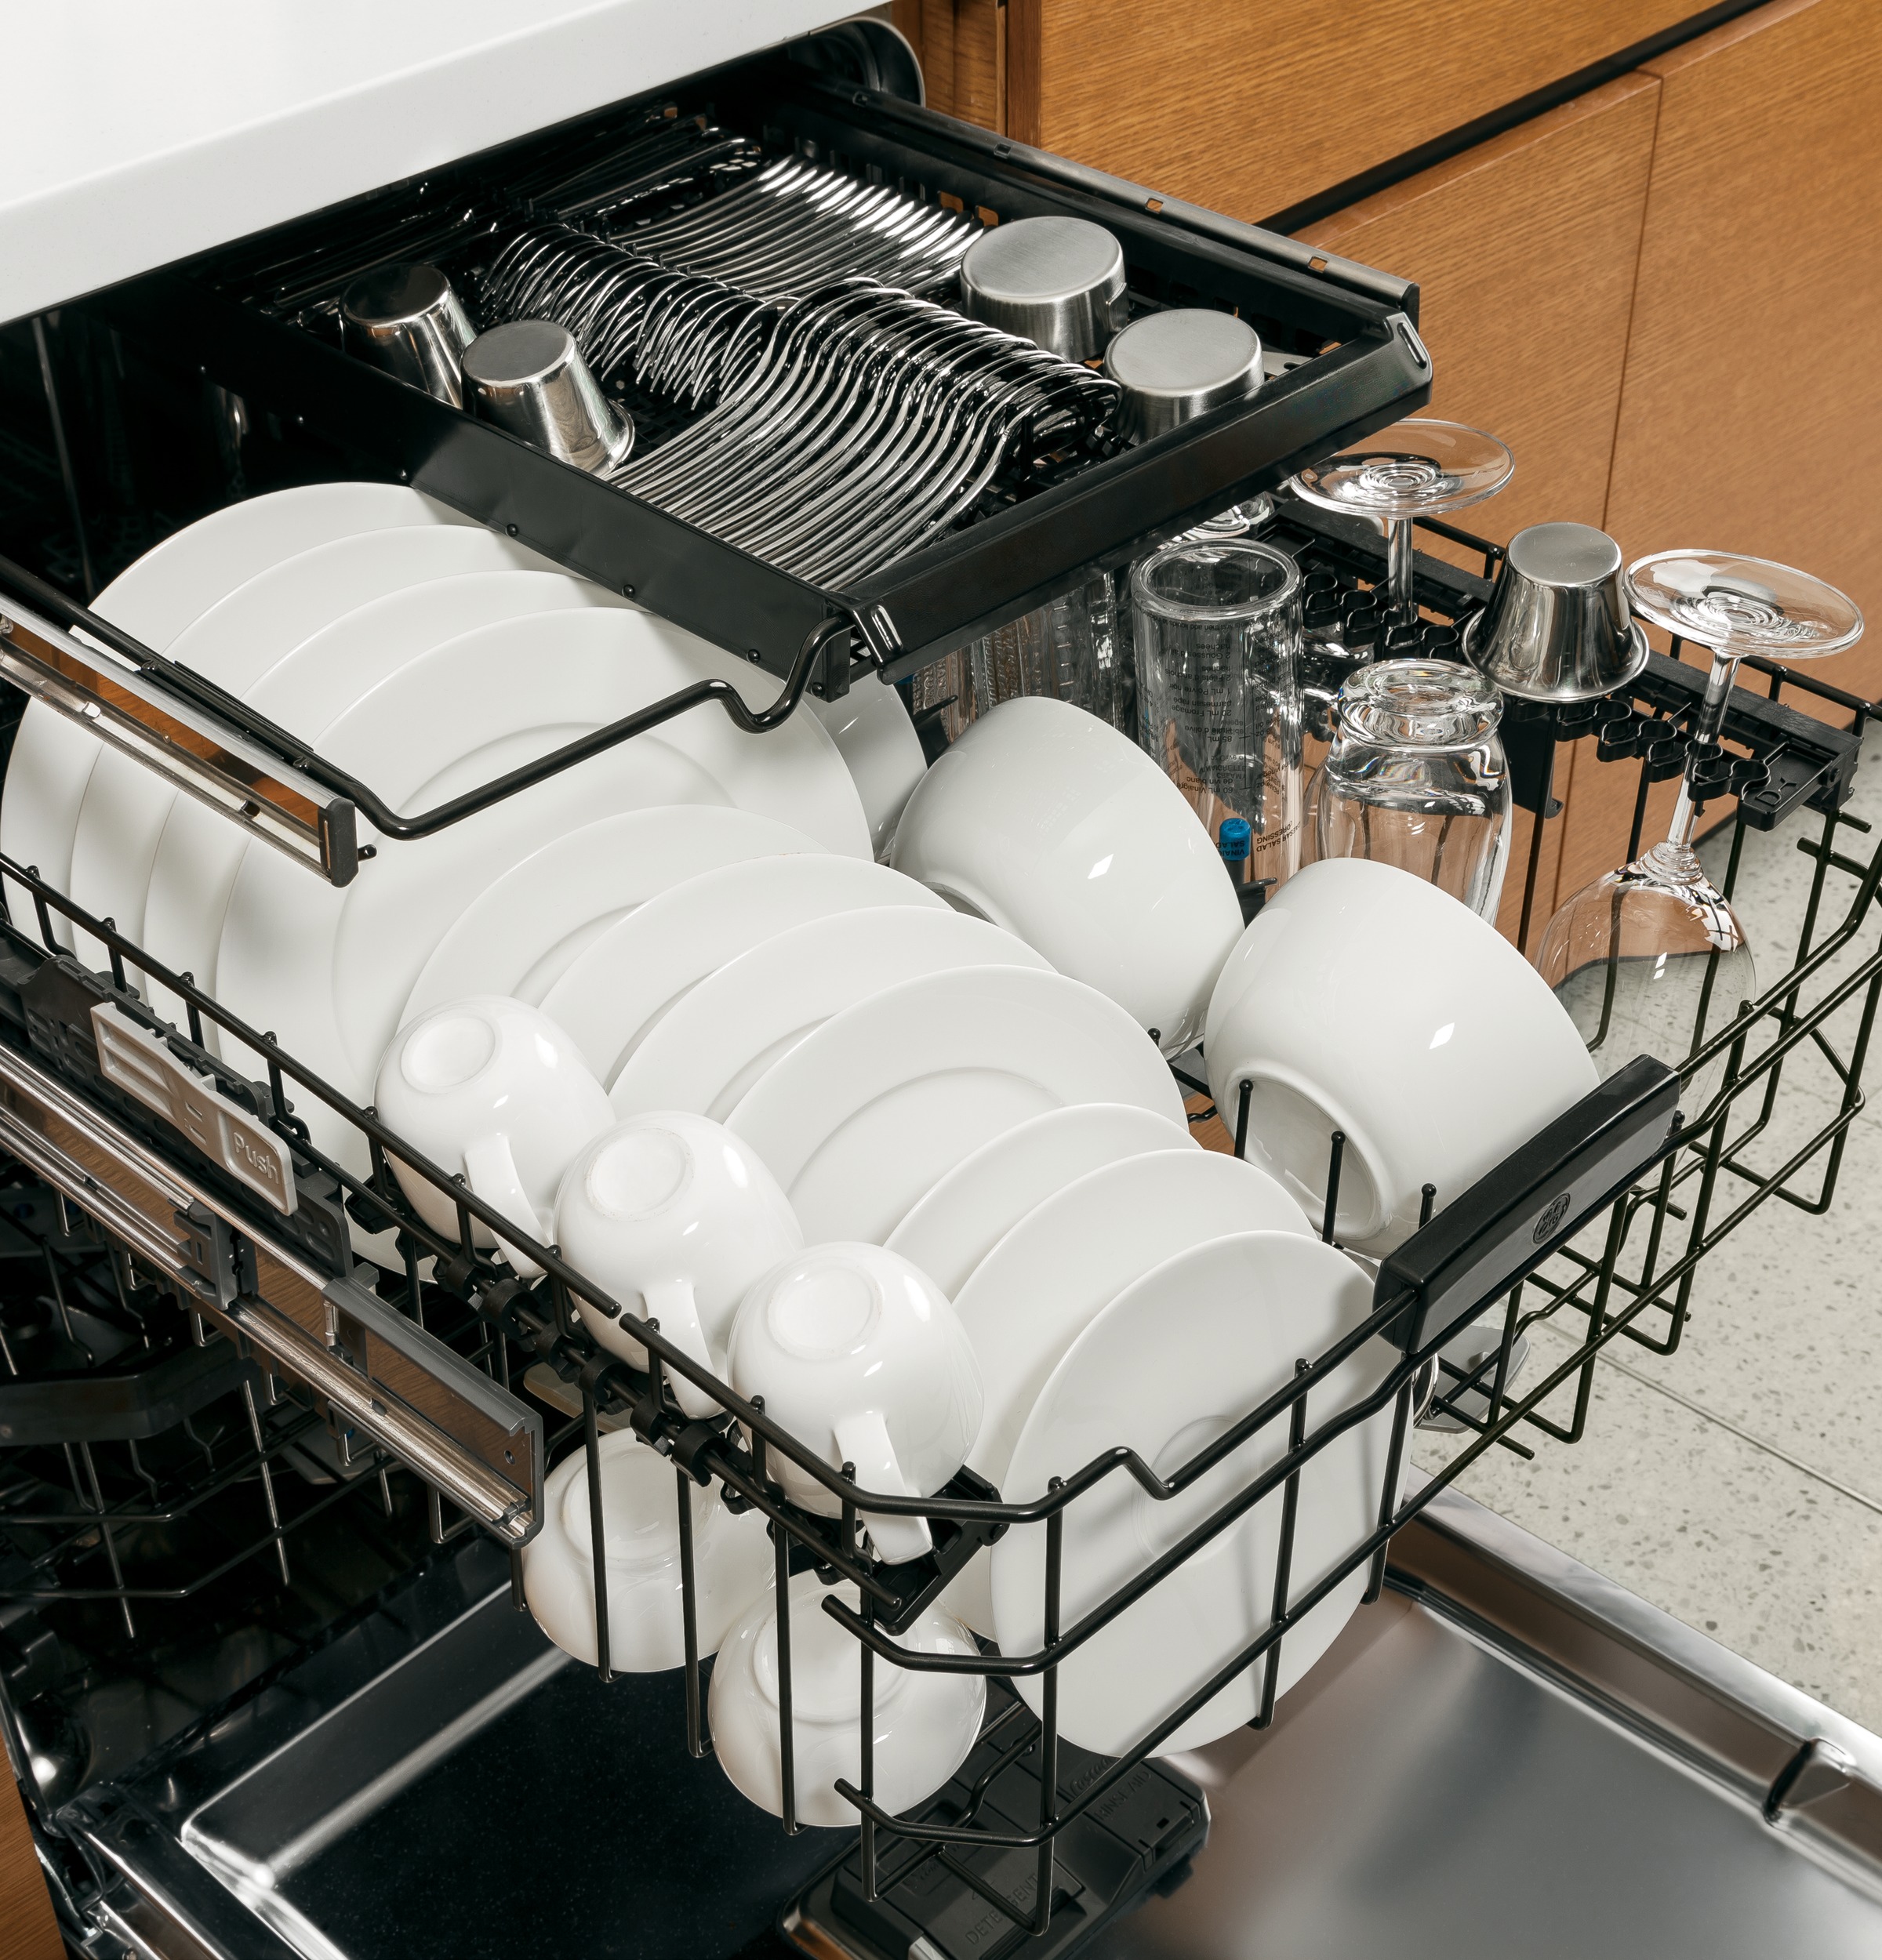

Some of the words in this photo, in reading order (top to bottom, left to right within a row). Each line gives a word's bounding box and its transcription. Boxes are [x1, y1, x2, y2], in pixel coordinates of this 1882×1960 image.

[1164, 669, 1199, 680] d'anchois
[1184, 686, 1209, 695] Poivre
[1172, 705, 1204, 717] Fromage
[1185, 725, 1209, 734] d'olive
[1176, 782, 1206, 793] Vinaigre
[1256, 823, 1291, 844] DRESSING
[1256, 837, 1281, 852] SALAD
[234, 1132, 279, 1185] Push
[1094, 1789, 1128, 1820] RINSE
[1128, 1771, 1151, 1793] AID
[965, 1871, 1038, 1945] DETEGENT
